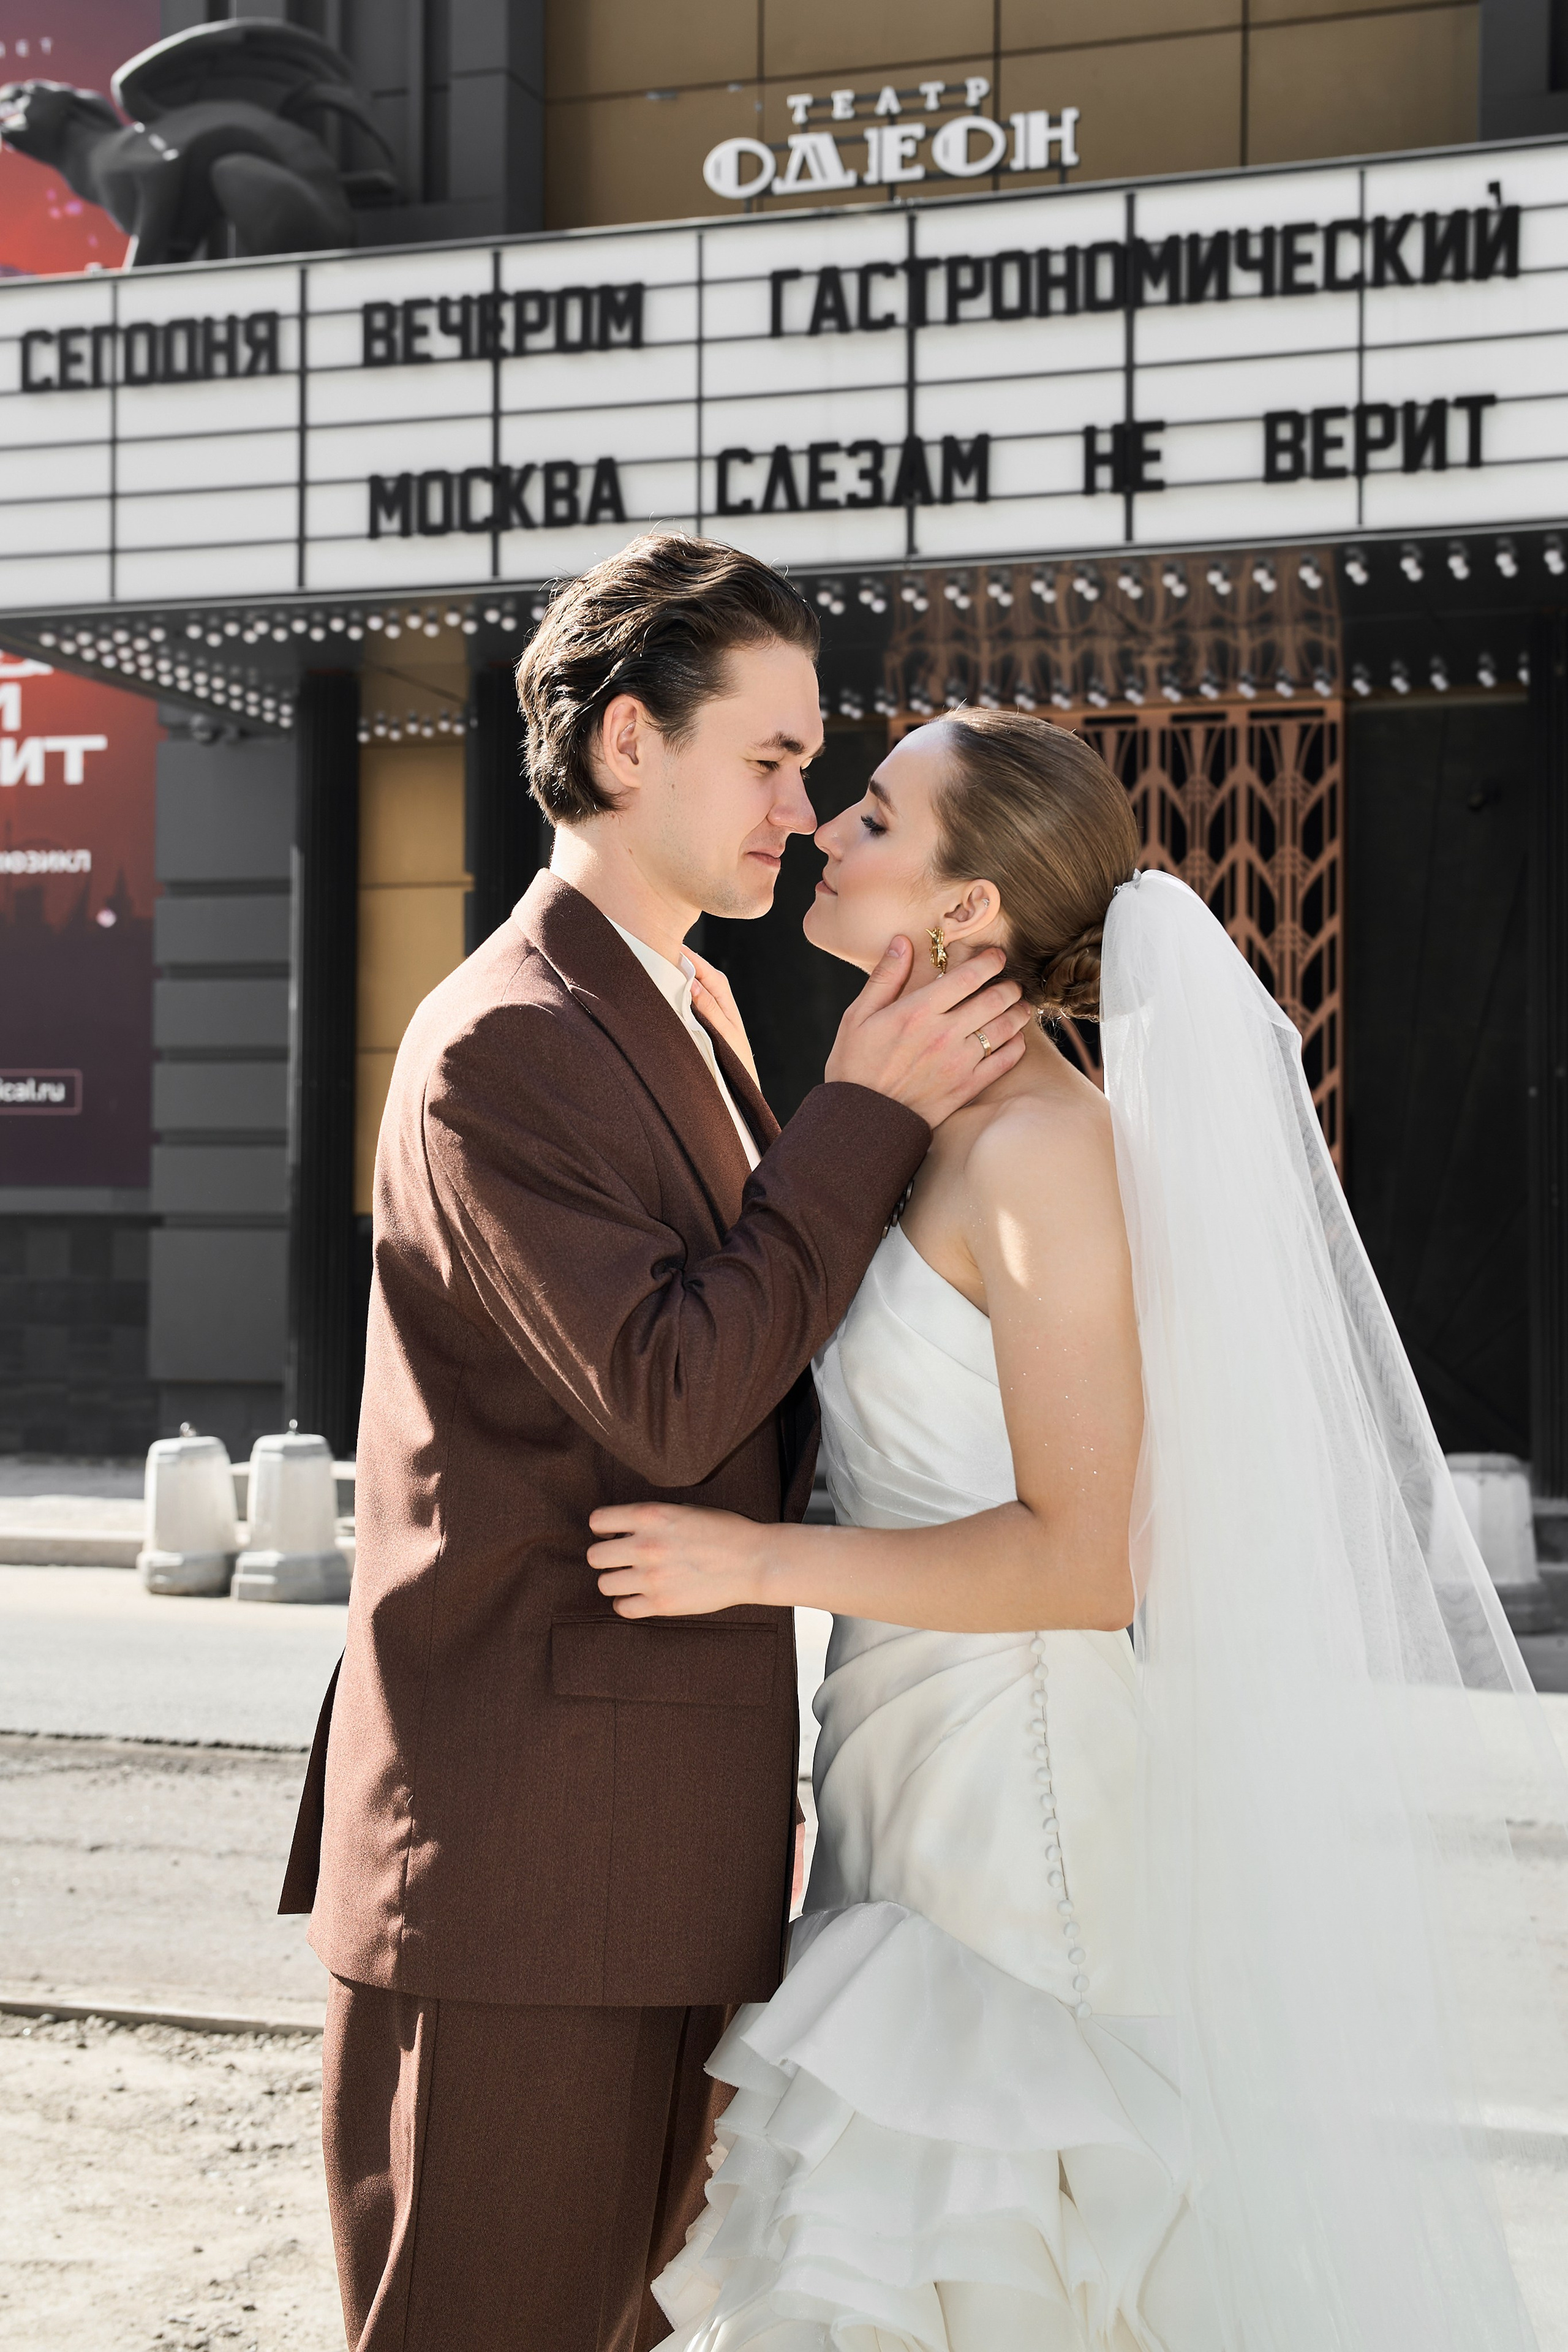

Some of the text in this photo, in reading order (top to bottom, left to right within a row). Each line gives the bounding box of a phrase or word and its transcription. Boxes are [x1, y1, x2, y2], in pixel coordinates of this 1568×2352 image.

[786, 76, 990, 124] ТЕАТР
[703, 107, 1080, 199] ОДЕОН
[21, 181, 1521, 392] СЕГОДНЯ ВЕЧЕРОМ ГАСТРОНОМИЧЕСКИЙ
[369, 394, 1498, 540] МОСКВА СЛЕЗАМ НЕ ВЕРИТ
[0, 849, 91, 875] ЮЗИКЛ
